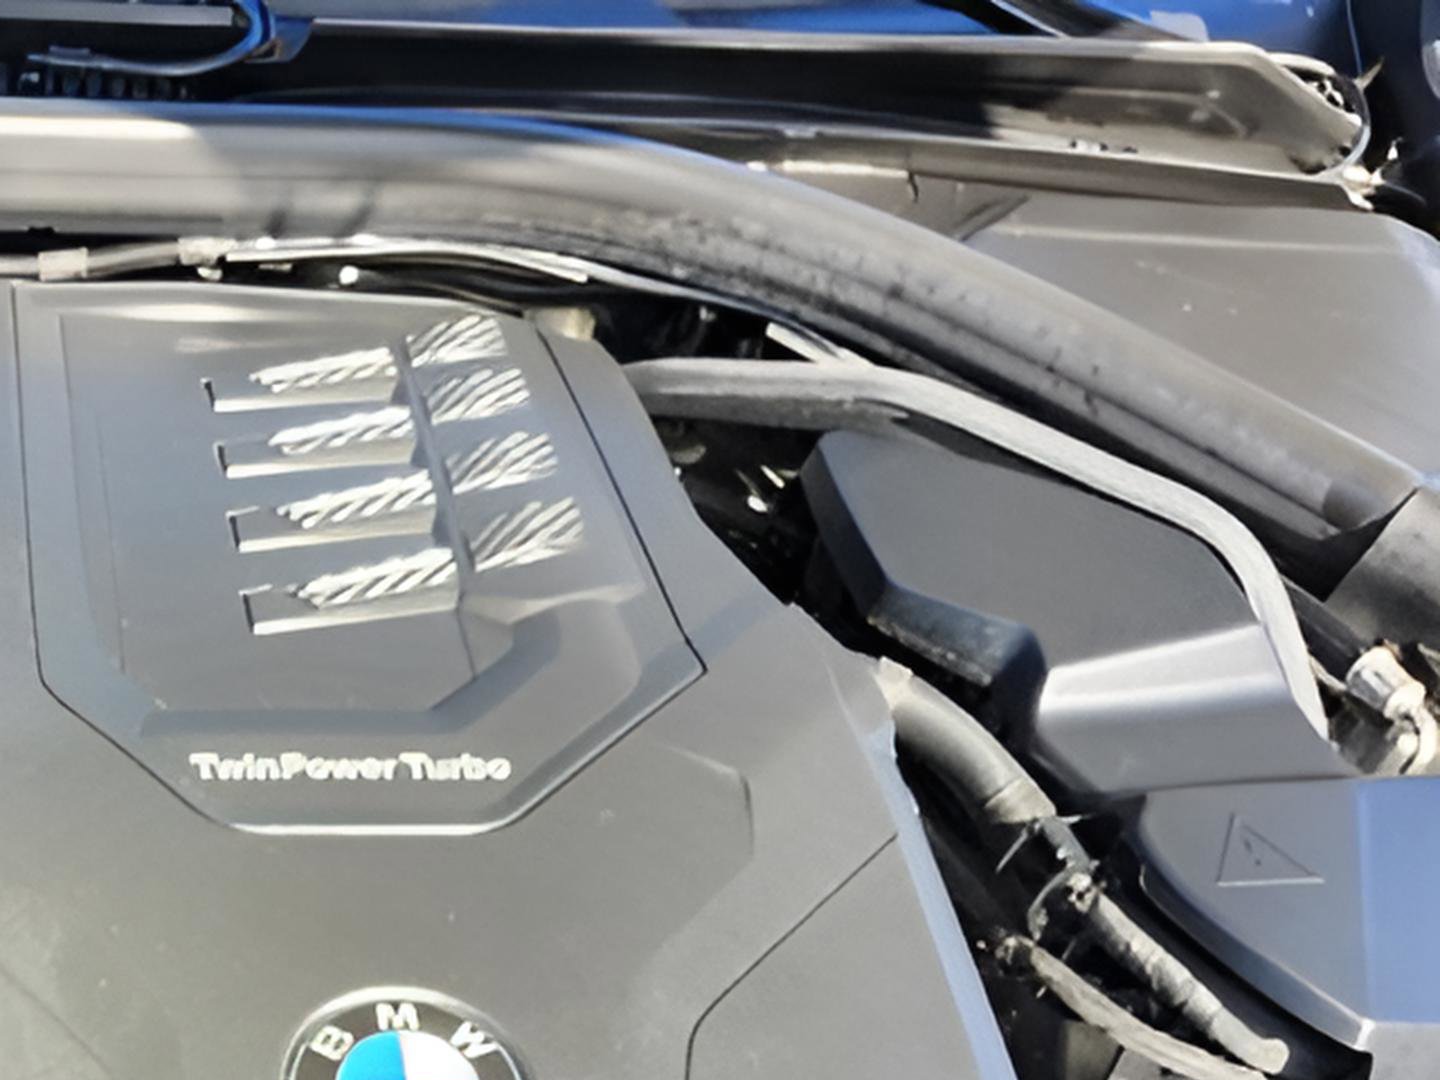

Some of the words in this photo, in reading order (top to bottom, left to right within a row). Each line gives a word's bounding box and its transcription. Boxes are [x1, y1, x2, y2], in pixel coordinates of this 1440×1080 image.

[189, 752, 395, 781] TwinPower
[398, 752, 512, 781] Turbo
[309, 1002, 498, 1060] BMW
